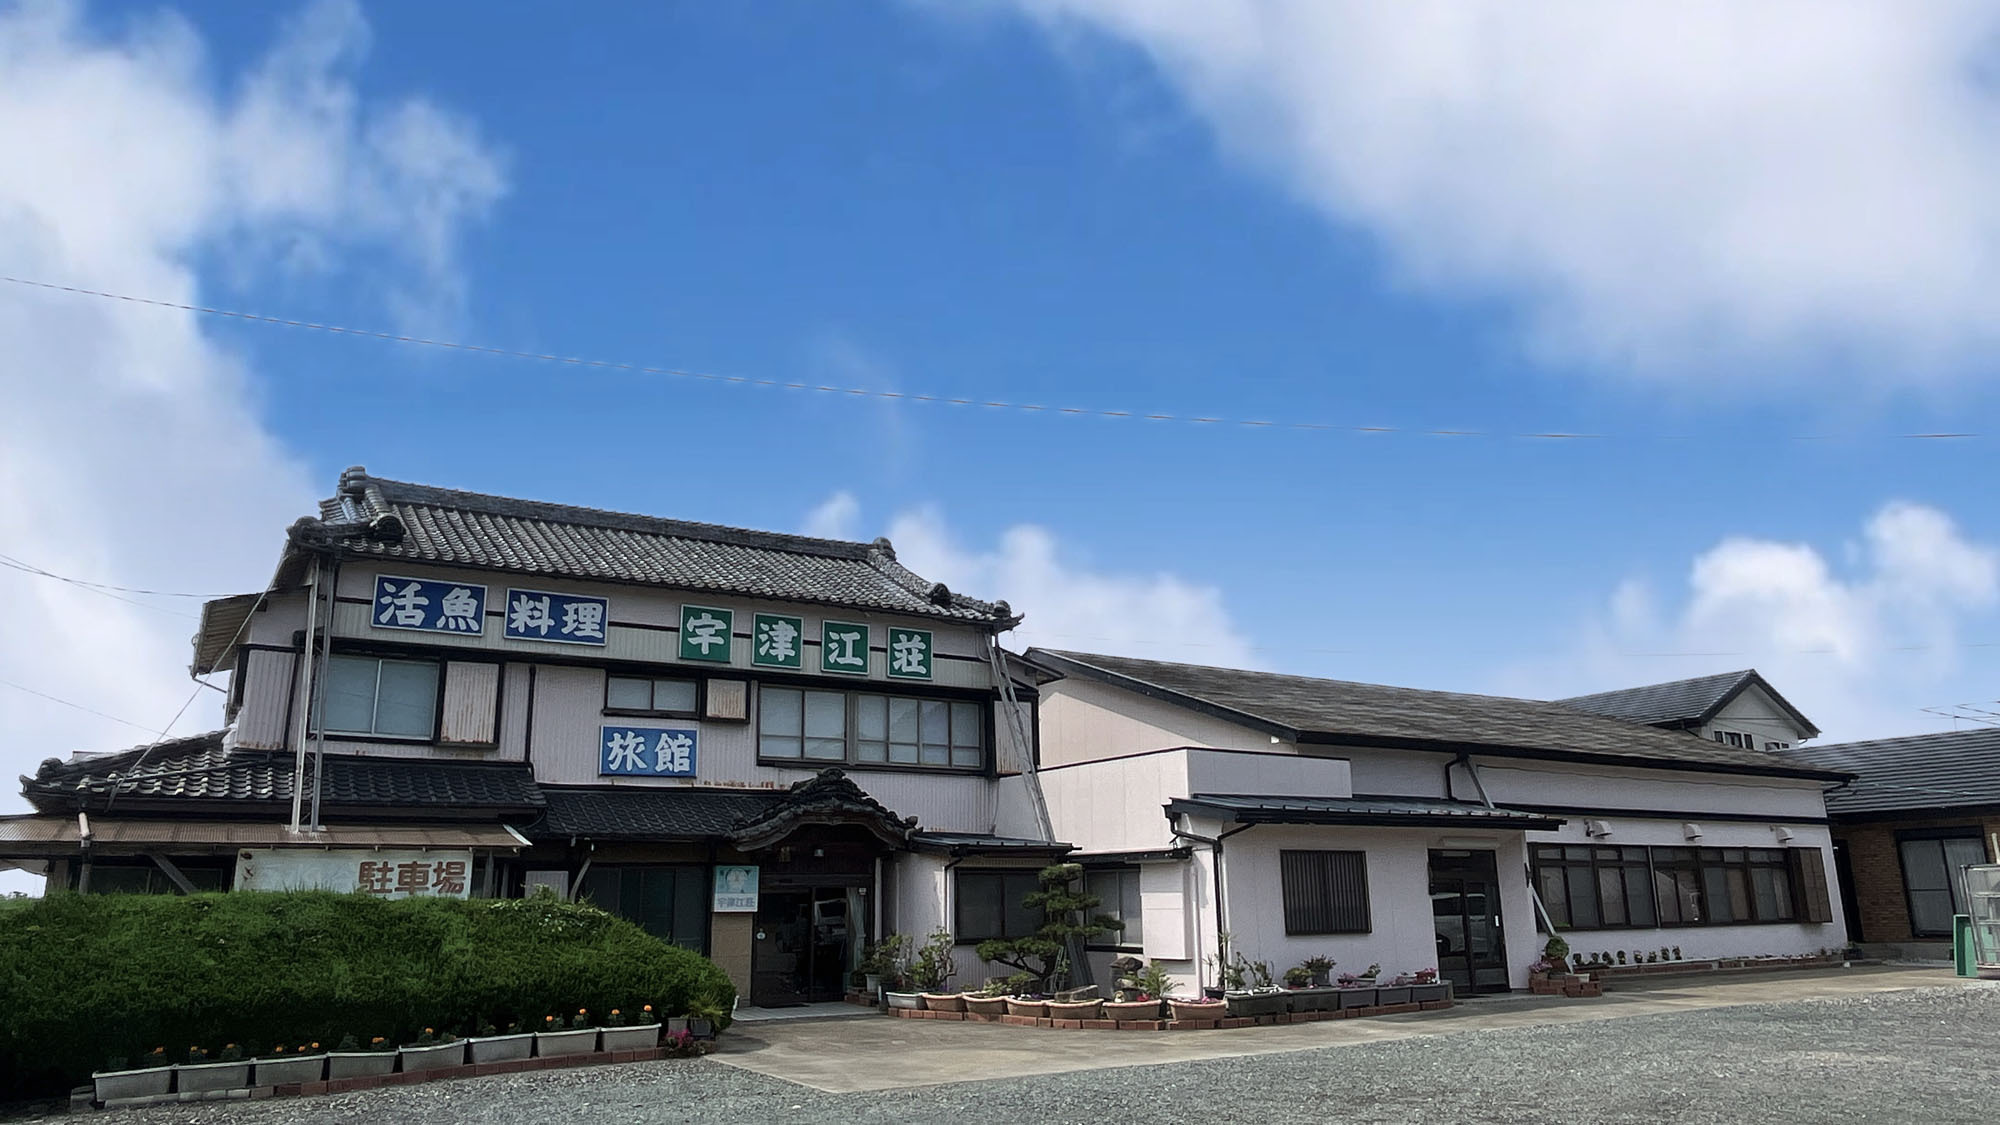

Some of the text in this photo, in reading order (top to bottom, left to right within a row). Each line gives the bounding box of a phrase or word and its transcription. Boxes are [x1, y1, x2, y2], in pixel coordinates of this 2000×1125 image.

[378, 581, 604, 639] 活魚 料理
[686, 612, 927, 675] 宇津江荘
[606, 730, 693, 773] 旅館
[358, 860, 466, 895] 駐車場
